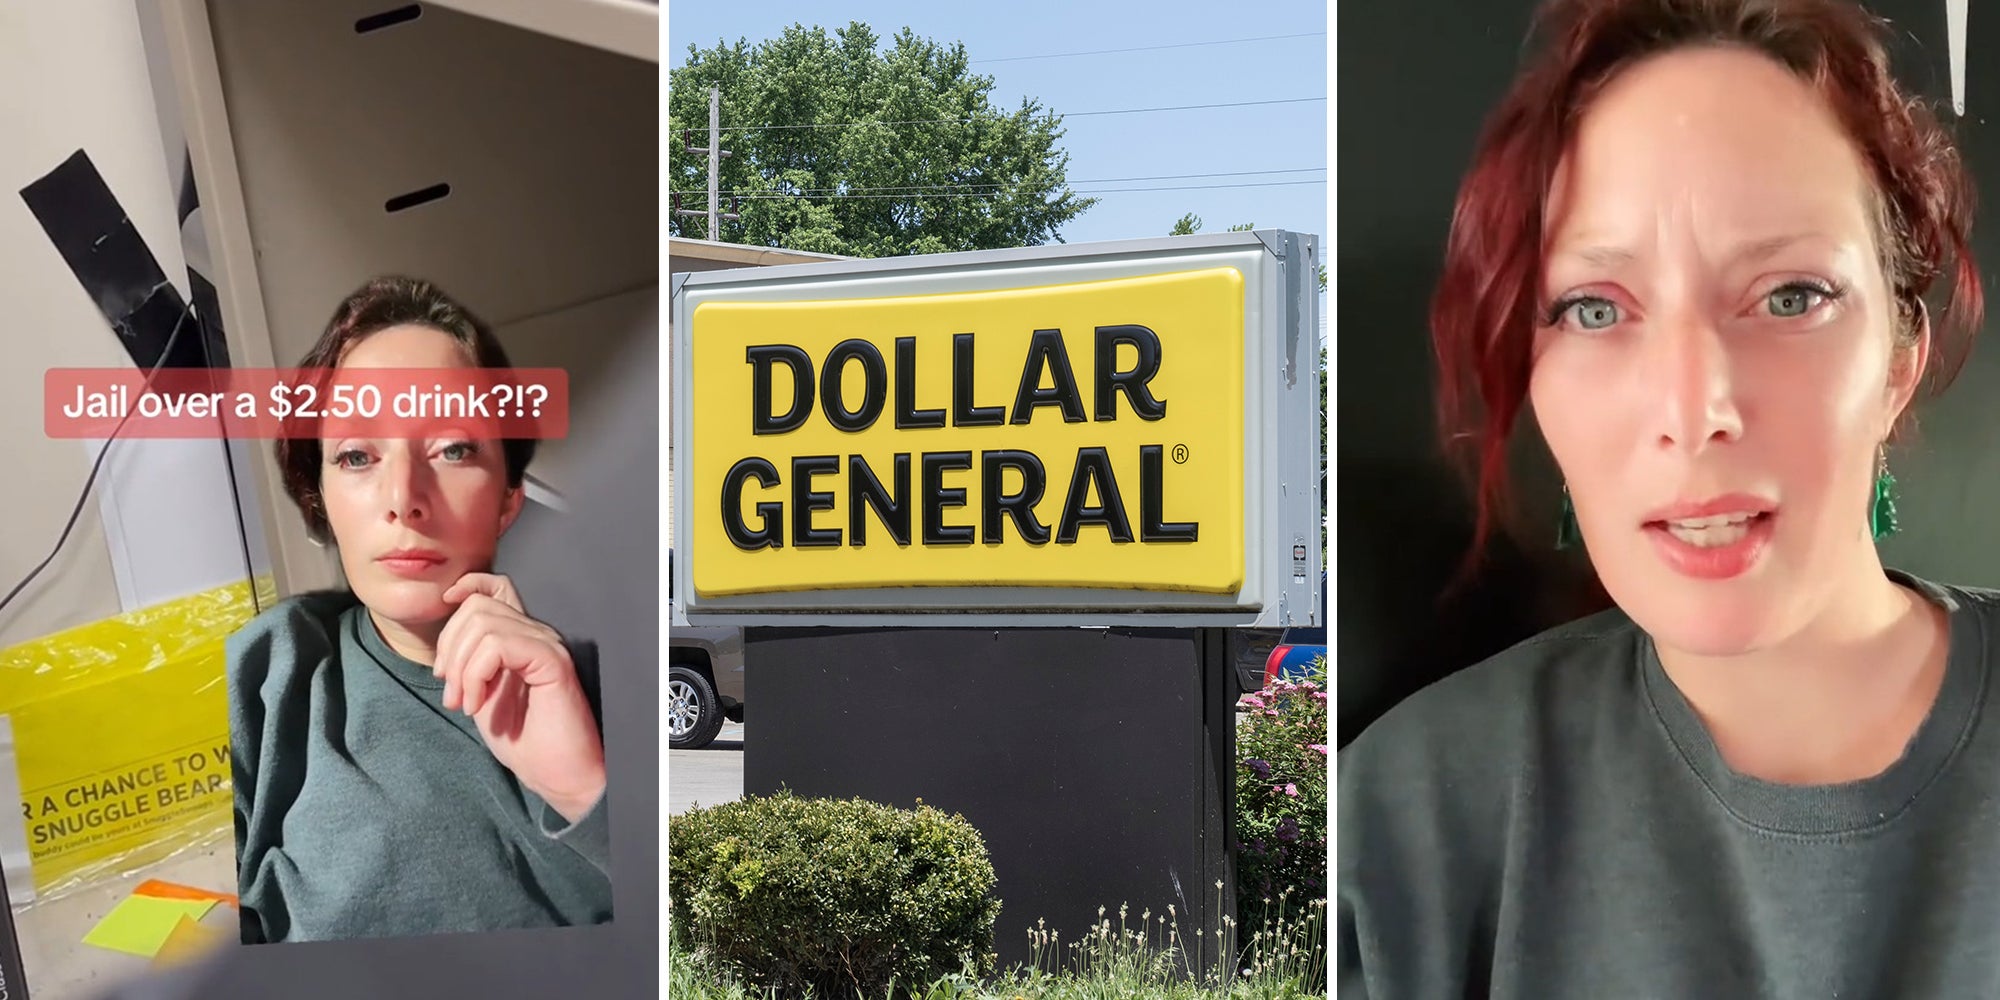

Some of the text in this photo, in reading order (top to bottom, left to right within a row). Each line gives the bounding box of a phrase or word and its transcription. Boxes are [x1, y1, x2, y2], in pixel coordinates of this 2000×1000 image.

[746, 324, 1168, 436] DOLLAR
[721, 444, 1199, 552] GENERAL
[33, 773, 223, 844] SNUGGLE BEAR
[41, 796, 59, 816] A
[65, 763, 167, 808] CHANCE
[172, 752, 206, 776] TO
[32, 844, 62, 859] buddy
[64, 835, 91, 849] could
